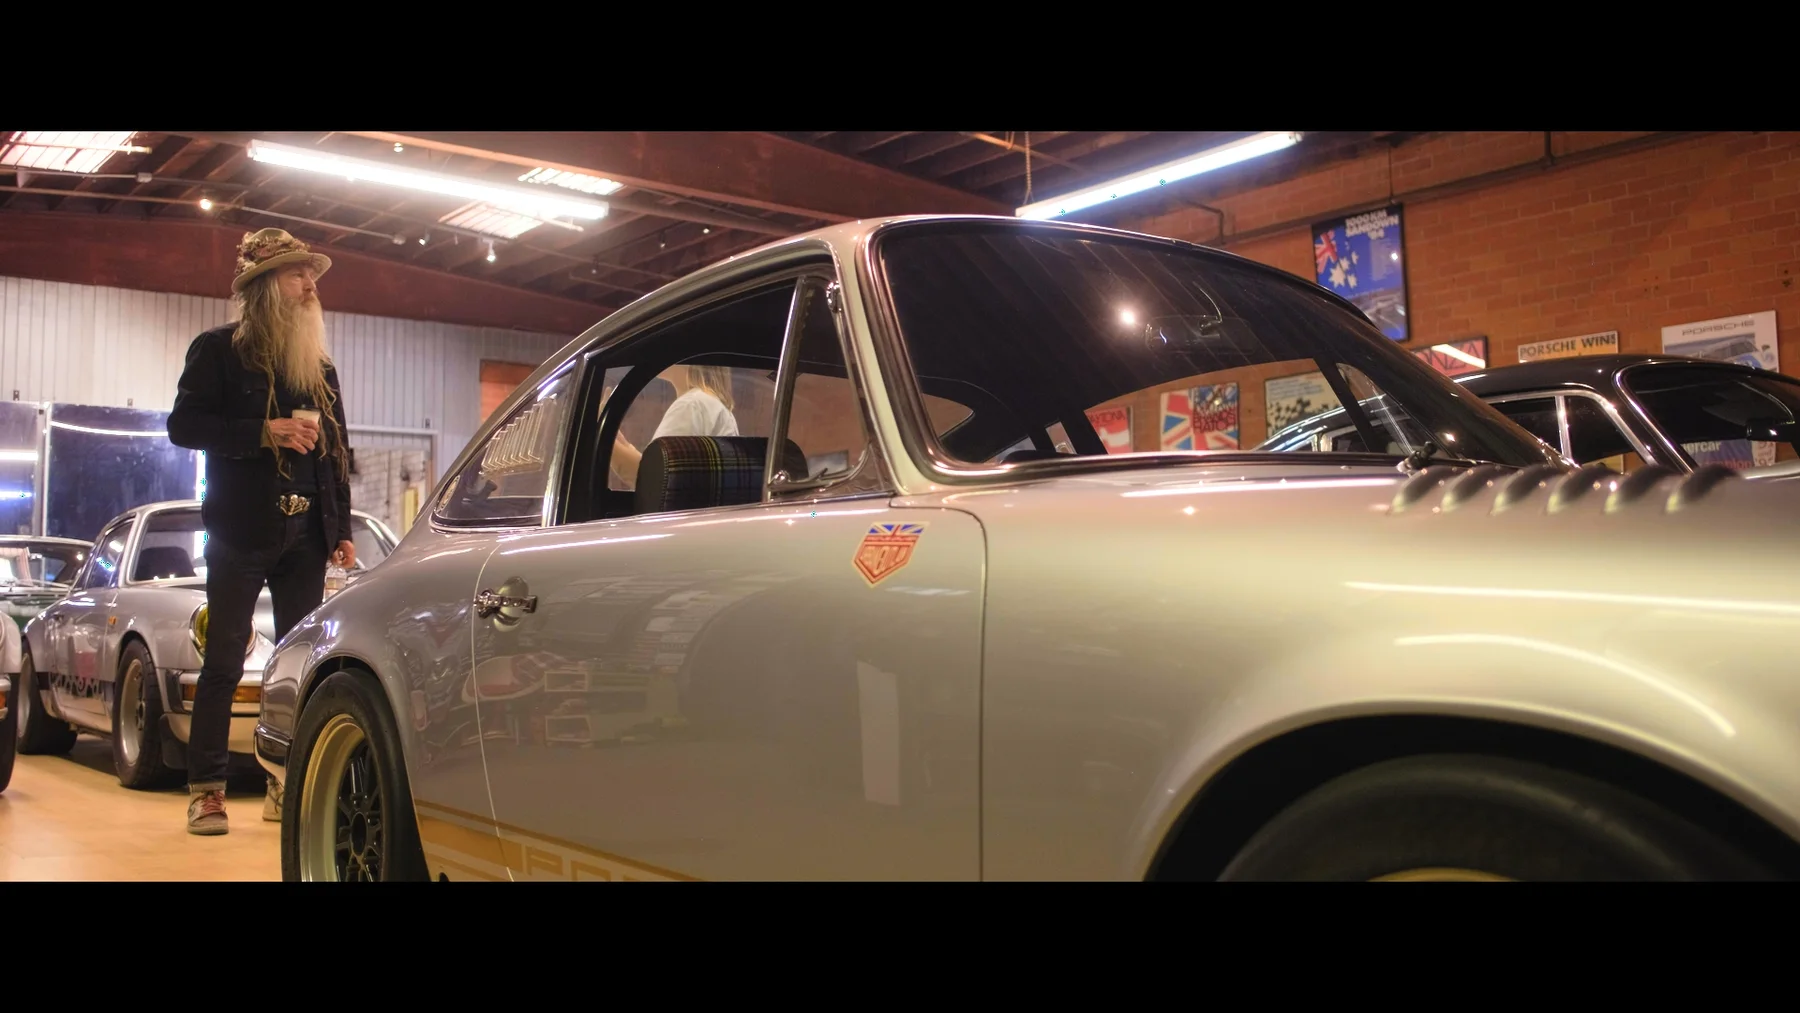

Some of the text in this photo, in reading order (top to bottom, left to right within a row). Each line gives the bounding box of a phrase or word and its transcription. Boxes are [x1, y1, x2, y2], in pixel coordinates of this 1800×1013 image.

[1682, 319, 1755, 336] PORSCHE
[1519, 333, 1616, 358] PORSCHE WINS
